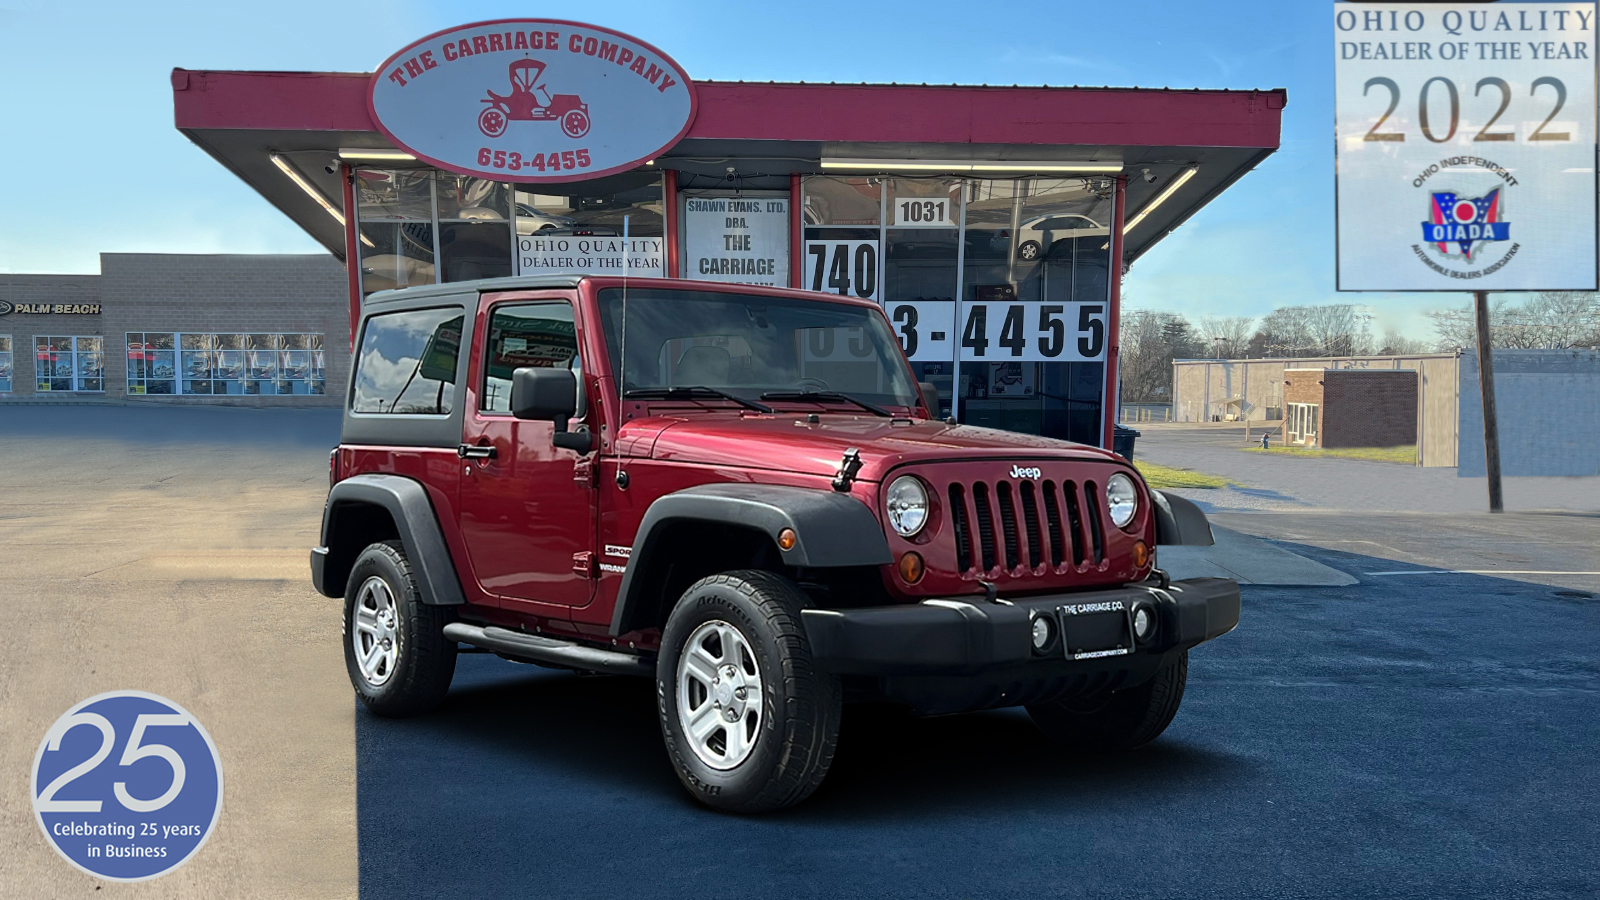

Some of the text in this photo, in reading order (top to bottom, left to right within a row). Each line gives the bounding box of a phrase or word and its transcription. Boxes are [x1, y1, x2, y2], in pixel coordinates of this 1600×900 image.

[1337, 10, 1593, 36] OHIO QUALITY
[1340, 42, 1589, 60] DEALER OF THE YEAR
[388, 31, 677, 93] THE CARRIAGE COMPANY
[1362, 76, 1571, 143] 2022
[477, 147, 592, 172] 653-4455
[1412, 155, 1520, 188] OHIO INDEPENDENT
[688, 200, 726, 212] SHAWN
[766, 202, 786, 213] LTD.
[900, 201, 945, 222] 1031
[1432, 224, 1495, 240] OIADA
[520, 240, 569, 252] OHIO
[723, 234, 751, 251] THE
[523, 257, 660, 268] DEALER OF THE YEAR
[699, 258, 775, 275] CARRIAGE
[1411, 242, 1521, 279] AUTOMOBILE DEALERS ASSOCIATION
[808, 243, 876, 298] 740
[14, 303, 100, 314] PALM BEACH
[1009, 464, 1041, 480] Jeep
[606, 547, 632, 555] SPOR
[599, 563, 627, 573] WRAN
[1063, 605, 1078, 615] THE
[1077, 602, 1111, 613] CARRIAGE
